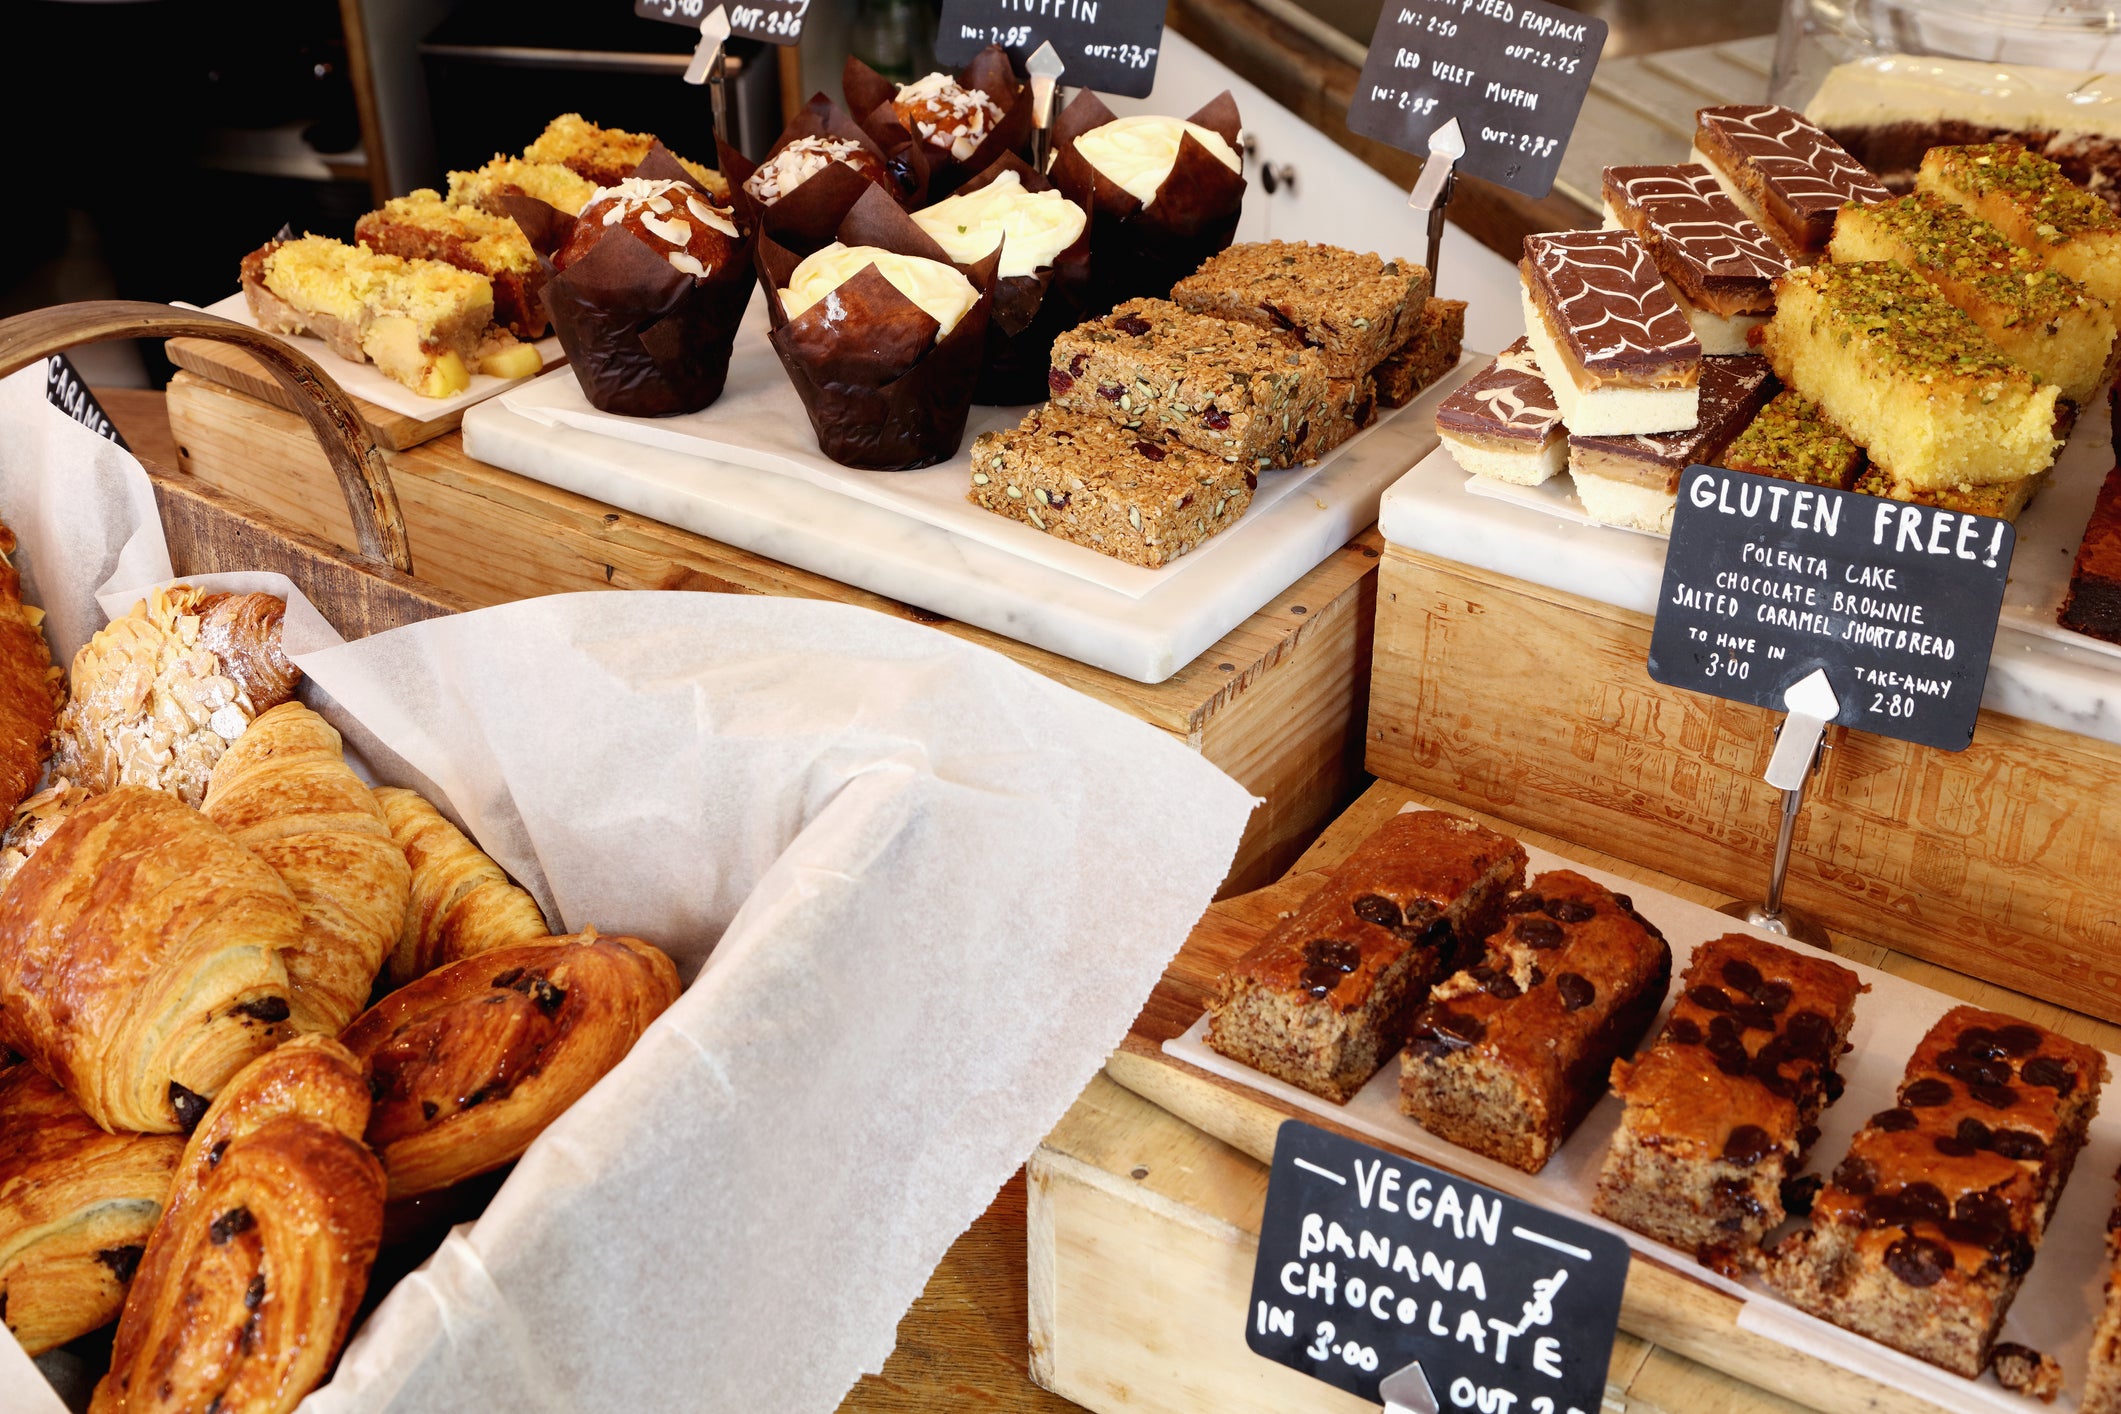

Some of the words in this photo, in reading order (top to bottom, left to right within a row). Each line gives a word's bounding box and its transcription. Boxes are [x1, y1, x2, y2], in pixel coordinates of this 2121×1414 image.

[1520, 11, 1587, 42] FLAPJACK
[1395, 48, 1420, 68] RED
[1432, 61, 1475, 86] VELET
[1485, 82, 1538, 110] MUFFIN
[1690, 473, 1842, 537] GLUTEN
[1874, 502, 2005, 568] FREE!
[1717, 572, 1816, 606] CHOCOLATE
[1832, 592, 1924, 625] BROWNIE
[1742, 543, 1828, 580] POLENTA
[1846, 565, 1897, 590] CAKE
[1673, 584, 1738, 617] SALTED
[1757, 604, 1832, 636] CARAMEL
[1842, 621, 1954, 660] SHORTBREAD
[1689, 627, 1707, 642] TO
[1717, 633, 1755, 653] HAVE
[1768, 645, 1785, 660] IN
[1854, 667, 1952, 699] TAKE-AWAY
[1354, 1159, 1502, 1246] VEGAN
[1299, 1213, 1487, 1301] BANANA
[1281, 1262, 1563, 1379] CHOCOLATE
[1257, 1301, 1294, 1337] IN
[1450, 1376, 1518, 1414] OUT
